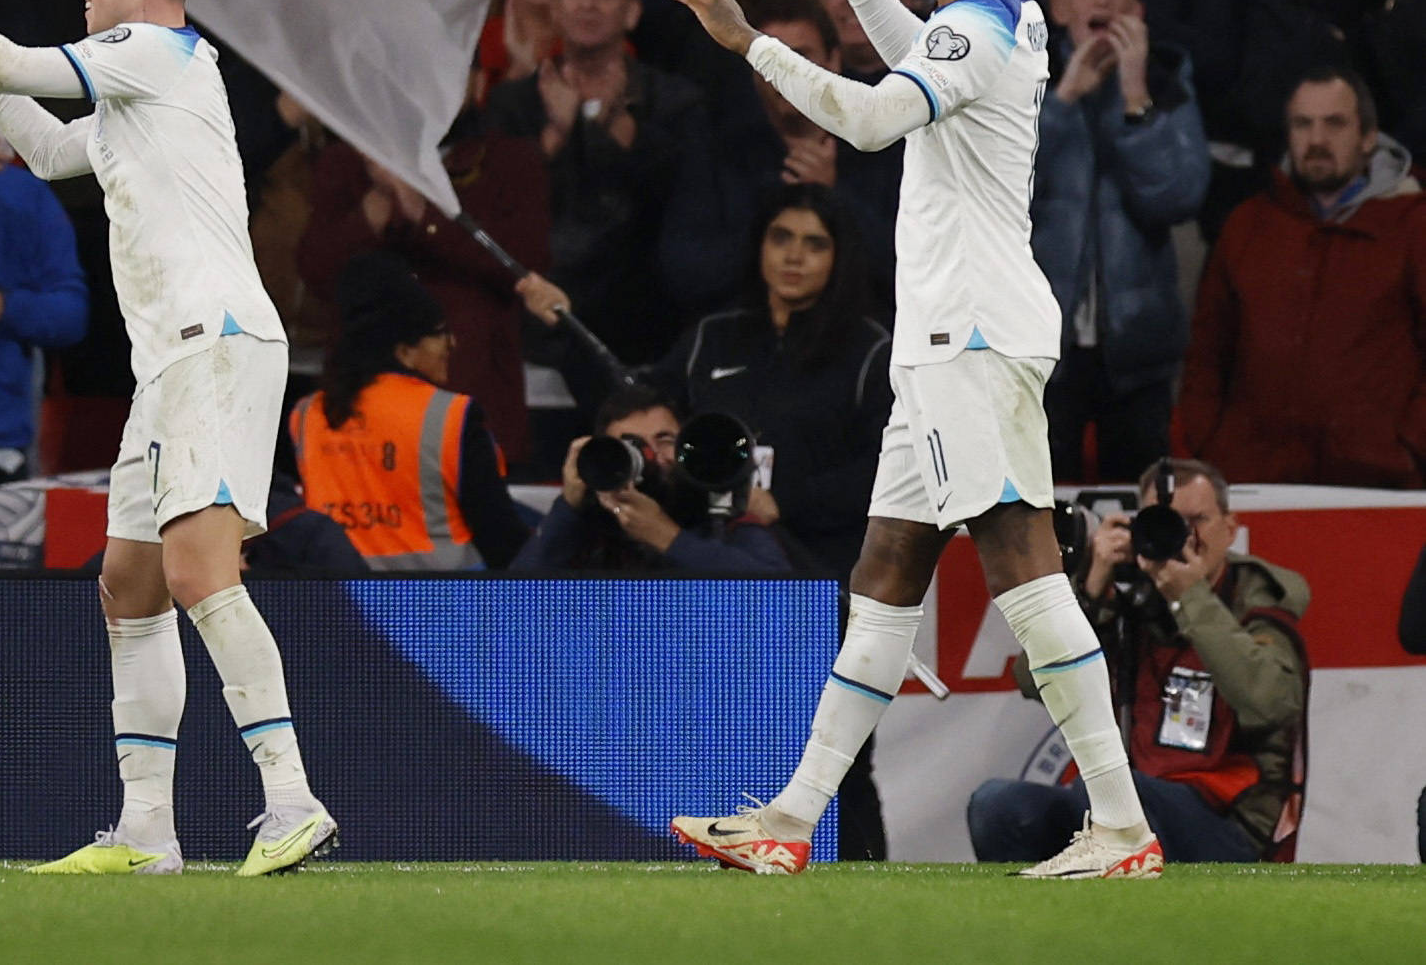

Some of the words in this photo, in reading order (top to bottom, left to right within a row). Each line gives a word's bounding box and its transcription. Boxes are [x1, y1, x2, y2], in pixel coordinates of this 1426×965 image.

[148, 441, 161, 494] 7
[382, 442, 396, 471] 8
[927, 428, 948, 487] 11
